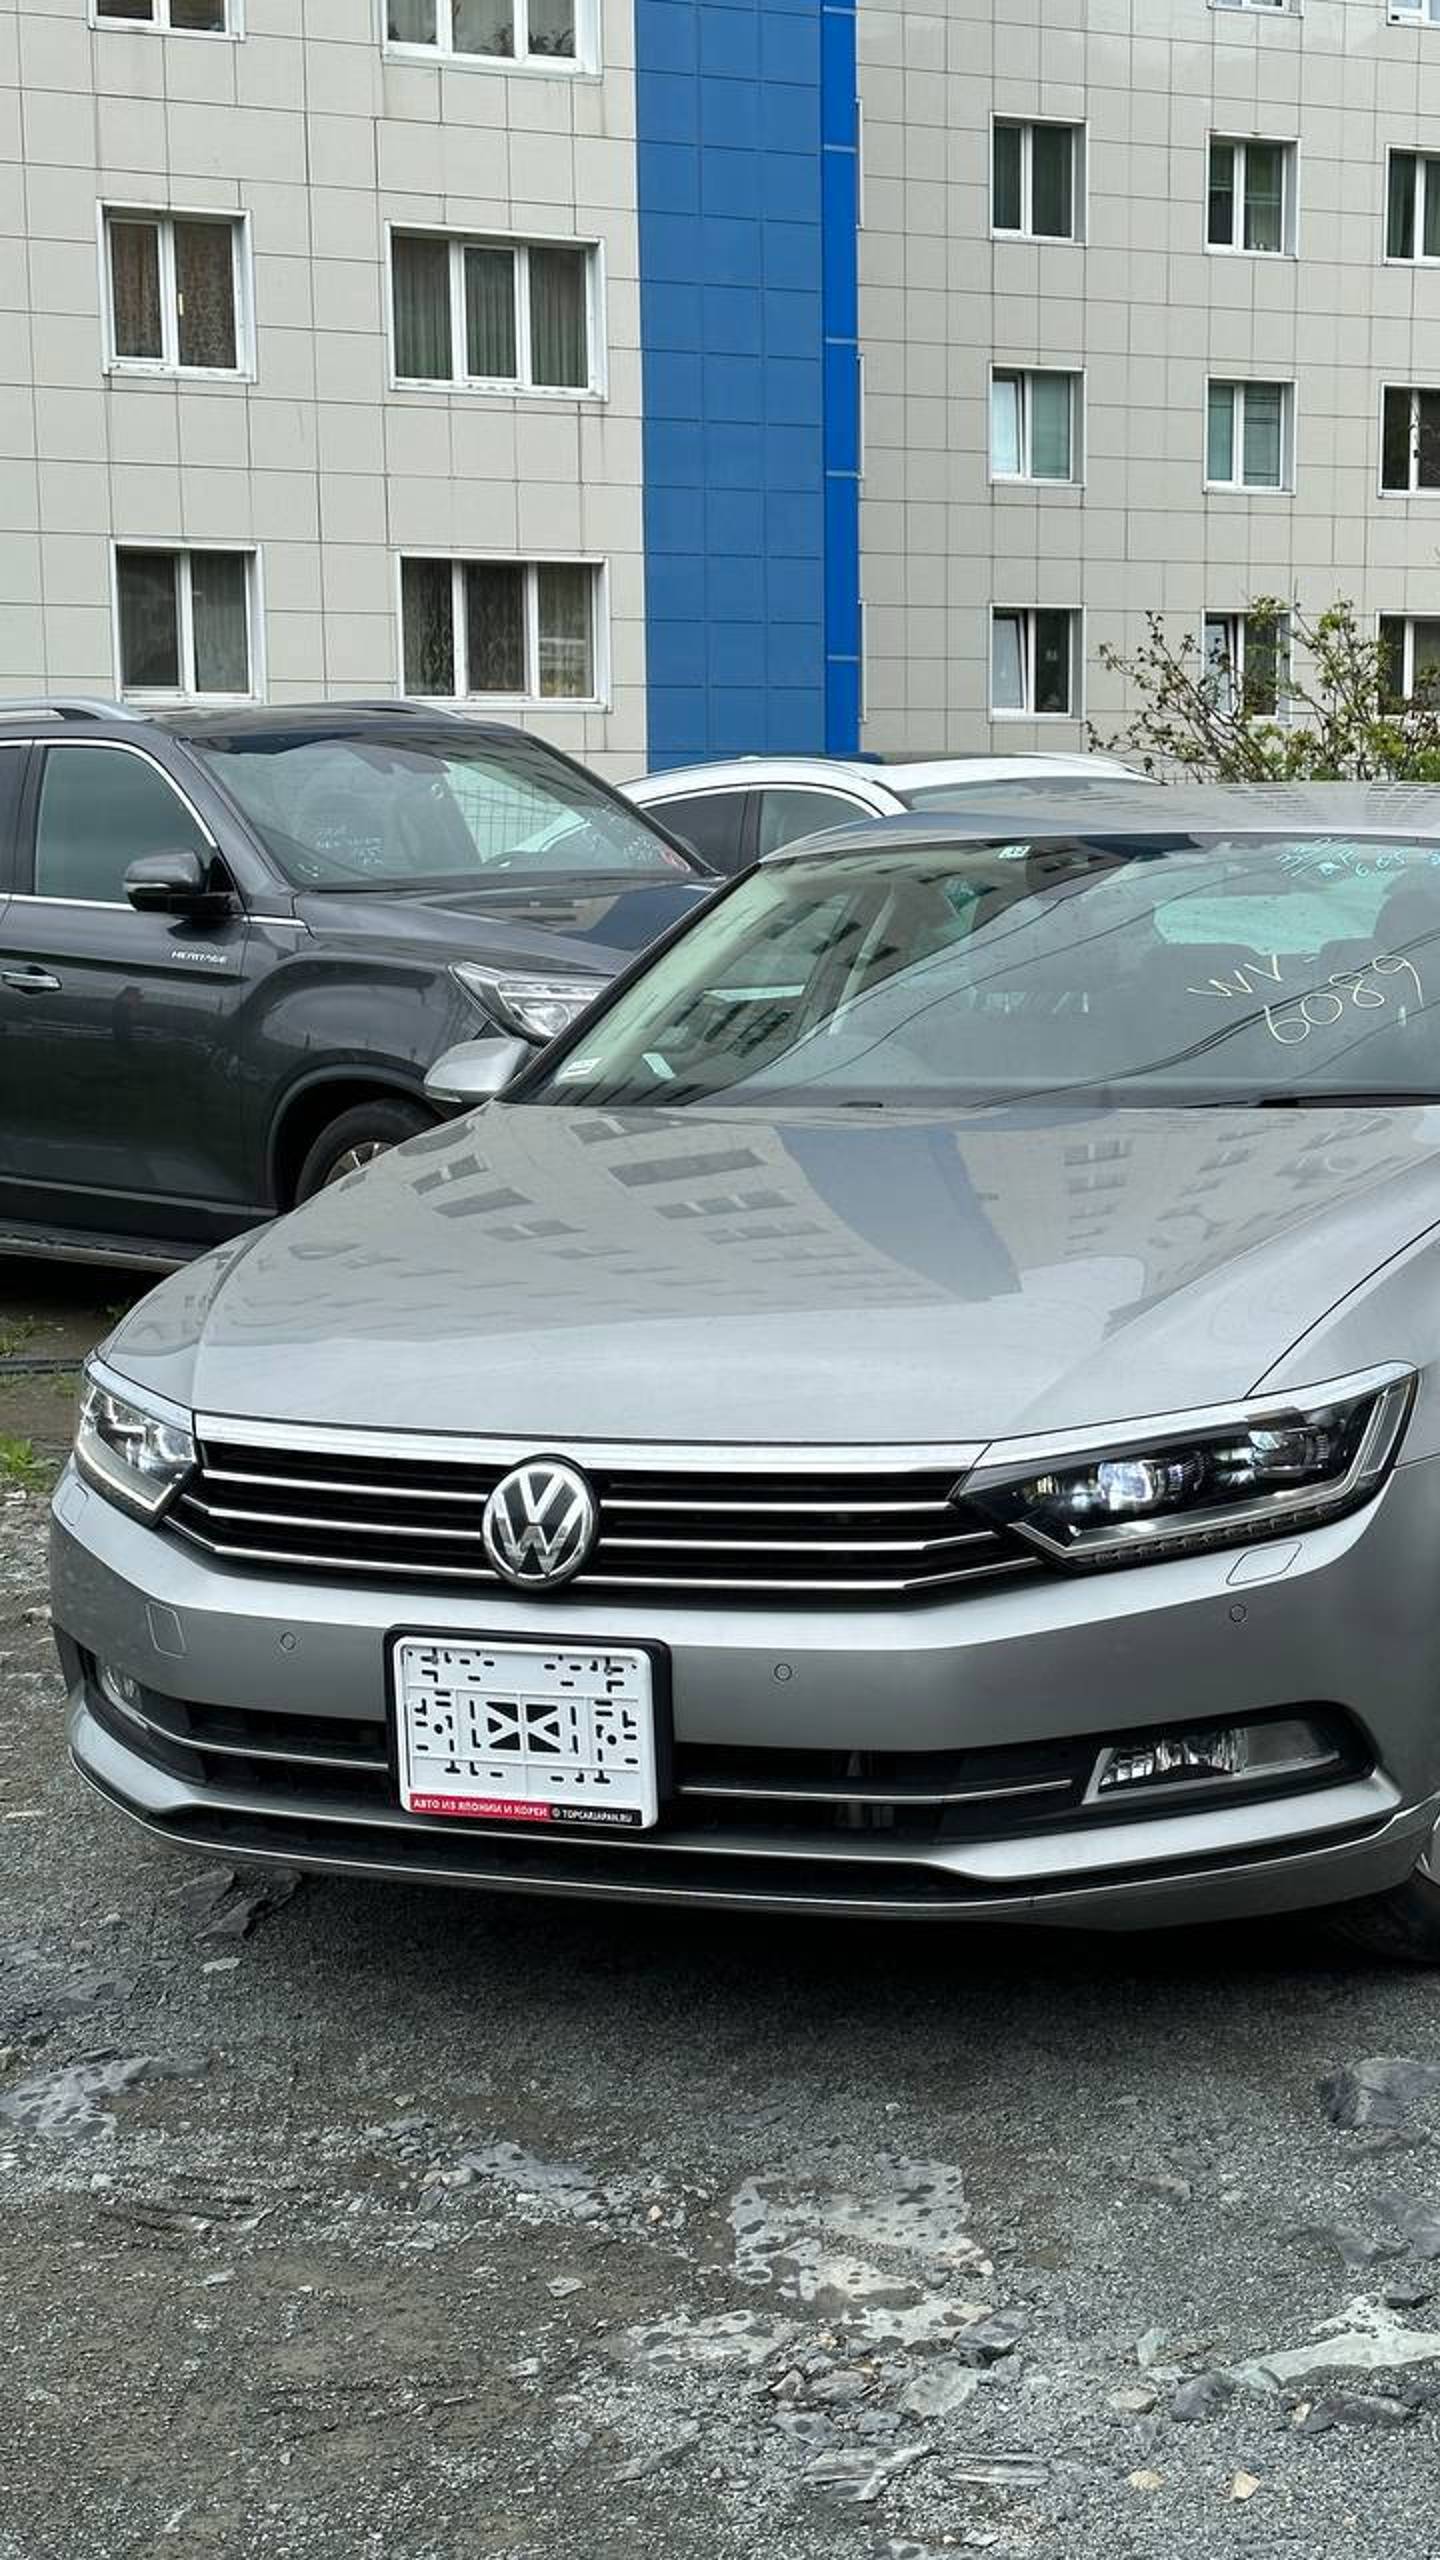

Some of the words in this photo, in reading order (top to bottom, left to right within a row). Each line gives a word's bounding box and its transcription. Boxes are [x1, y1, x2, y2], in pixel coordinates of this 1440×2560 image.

[171, 950, 228, 964] HERITAGE
[1263, 954, 1424, 1045] 6089
[413, 1799, 441, 1809] АВТО
[441, 1799, 456, 1810] ИЗ
[458, 1801, 502, 1813] ЯПОНИИ
[503, 1804, 513, 1814] И
[513, 1804, 548, 1817] КОРЕИ
[562, 1809, 633, 1823] TOPCARJAPAN.RU
